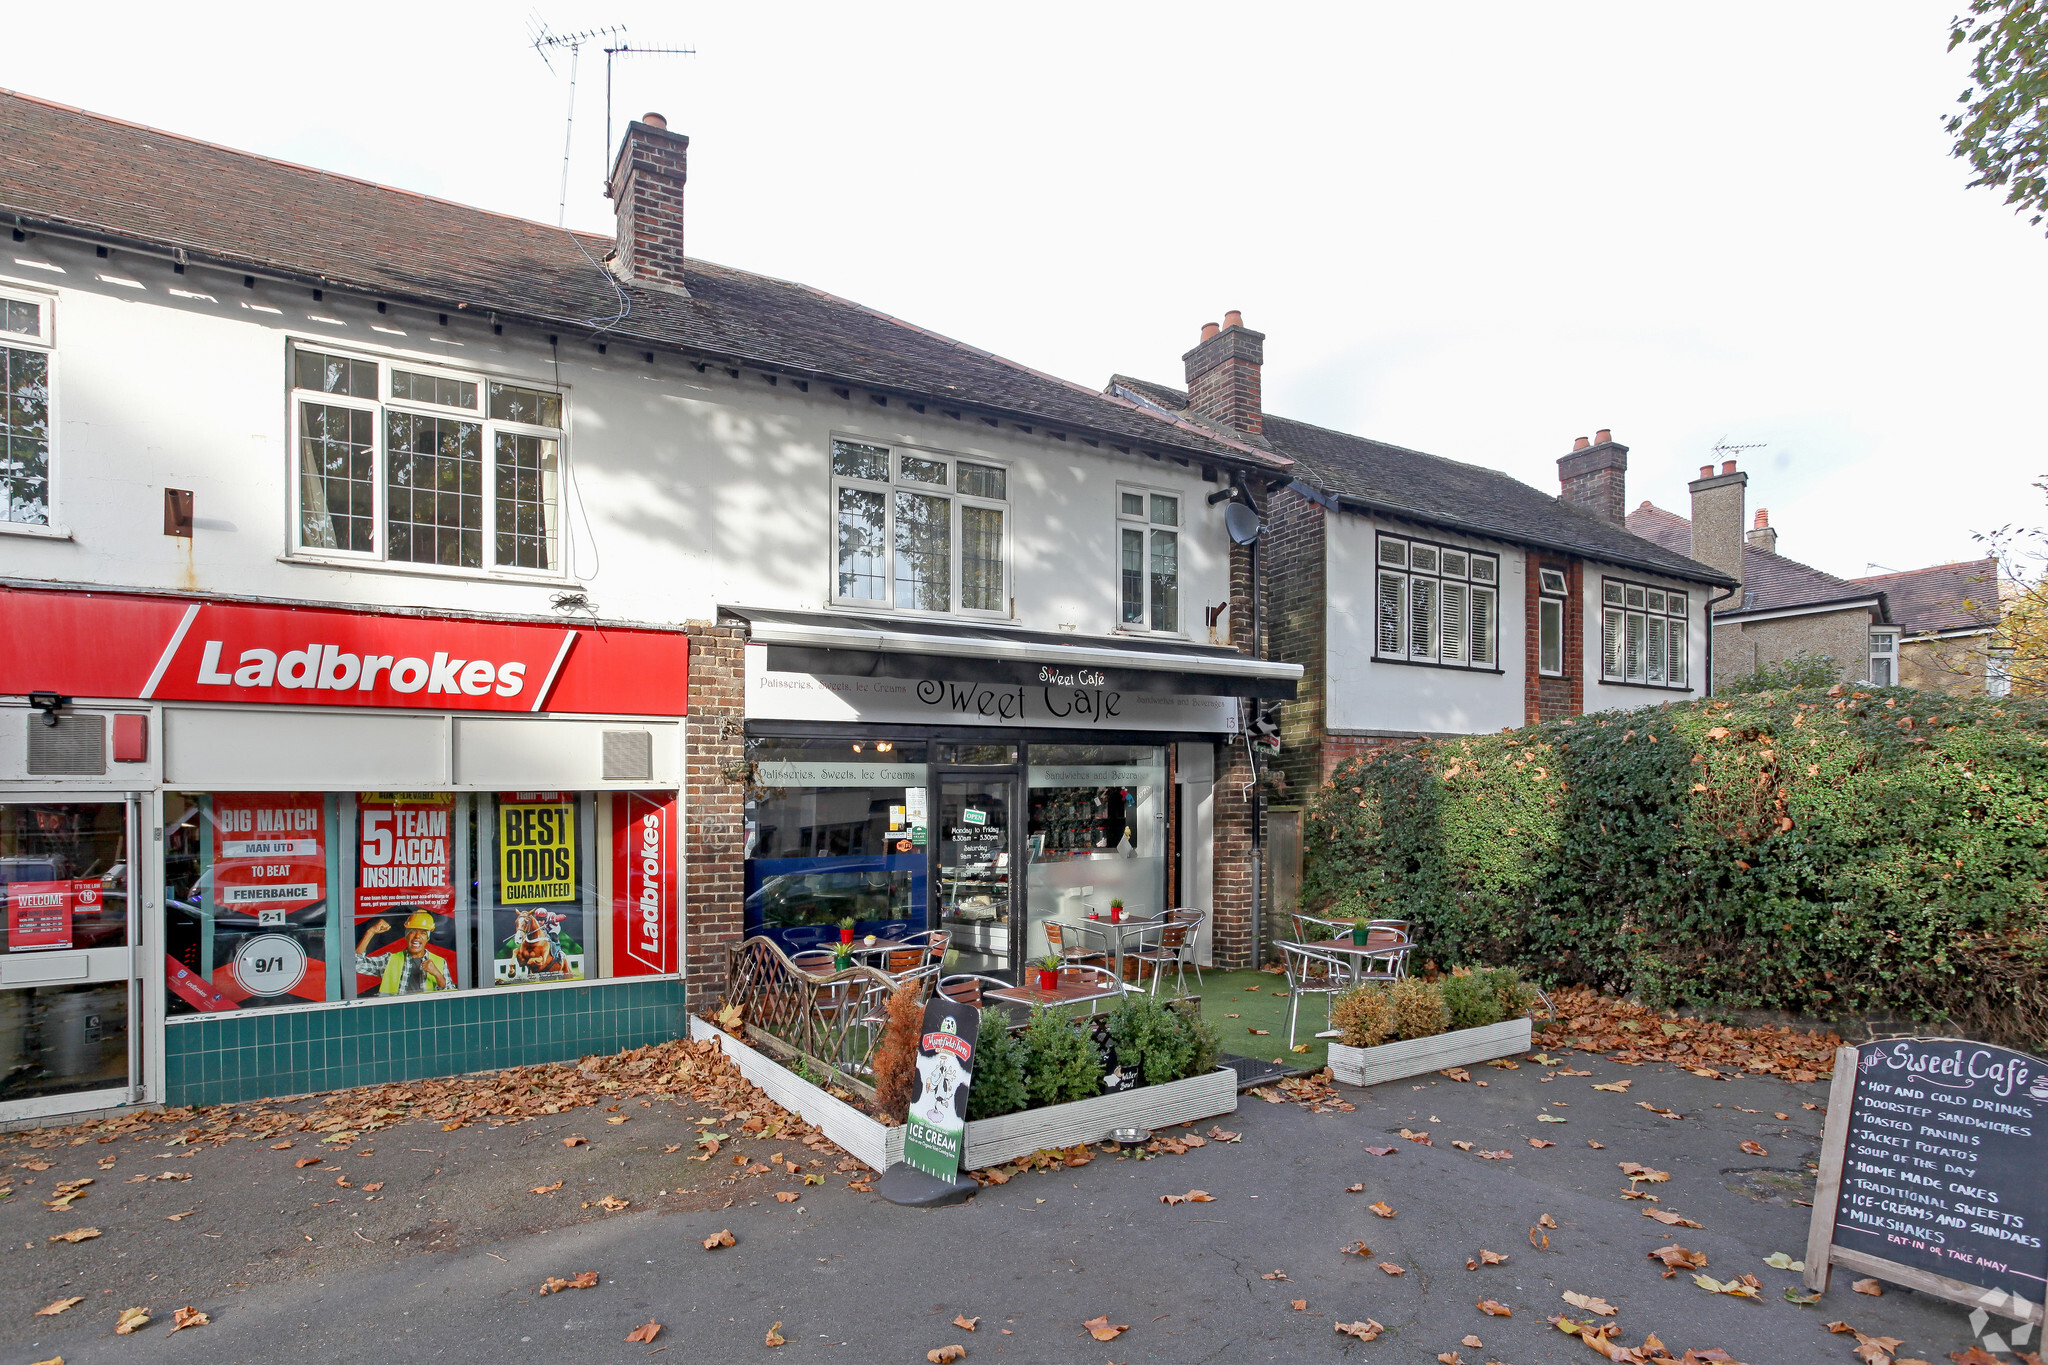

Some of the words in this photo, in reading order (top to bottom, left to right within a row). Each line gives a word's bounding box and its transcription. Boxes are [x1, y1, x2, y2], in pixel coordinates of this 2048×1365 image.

[197, 640, 526, 697] Ladbrokes
[1038, 666, 1075, 686] Sweet
[1078, 669, 1105, 687] Café
[759, 677, 814, 690] Patisseries,
[819, 680, 851, 692] Sweets,
[856, 682, 868, 692] Ice
[873, 682, 907, 693] Creams
[917, 680, 1025, 723] Sweet
[1178, 697, 1189, 706] and
[1192, 701, 1225, 709] Beverages
[1226, 717, 1236, 729] 13
[821, 768, 856, 780] Sweets,
[861, 769, 875, 780] Ice
[880, 769, 915, 780] Creams
[1045, 771, 1089, 780] Sandwiches
[1093, 771, 1107, 780] and
[222, 810, 252, 832] BIG
[257, 808, 318, 831] MATCH
[506, 808, 569, 846] BEST
[966, 813, 983, 821] OPEN
[983, 826, 999, 834] Friday
[246, 843, 270, 853] MAN
[274, 843, 294, 852] UTD
[363, 810, 392, 865] 5
[394, 810, 447, 837] TEAM
[394, 838, 446, 864] ACCA
[251, 865, 264, 877] TO
[267, 865, 291, 876] BEAT
[363, 866, 446, 888] INSURANCE
[506, 848, 570, 882] ODDS
[234, 888, 308, 900] FENERBAHCE
[507, 882, 571, 900] GUARANTEED
[640, 814, 659, 953] Ladbrokes
[18, 893, 64, 906] WELCOME
[262, 912, 281, 922] 2-1
[255, 957, 284, 972] 9/1
[1886, 1043, 1964, 1077] Sweet
[1968, 1050, 2029, 1097] Café
[1868, 1081, 1893, 1093] HOT
[1894, 1087, 1924, 1099] AND
[1930, 1092, 1967, 1106] COLD
[1972, 1099, 2033, 1119] DRINKS
[1861, 1112, 1913, 1132] TOASTED
[1920, 1126, 1981, 1146] PANINIS
[1864, 1098, 1932, 1118] DOORSTEP
[1937, 1112, 2032, 1137] SANDWICHES
[910, 1122, 924, 1138] ICE
[925, 1129, 956, 1152] CREAM
[1860, 1129, 1911, 1149] JACKET
[1915, 1141, 1978, 1162] POTATO'S
[1857, 1145, 1889, 1159] SOUP
[1893, 1153, 1910, 1164] OF
[1912, 1156, 1938, 1171] THE
[1944, 1163, 1976, 1179] DAY
[1856, 1161, 1896, 1178] HOME
[1900, 1171, 1943, 1190] MADE
[1949, 1183, 2000, 1204] CAKES
[1853, 1178, 1949, 1210] TRADITIONAL
[1954, 1203, 2025, 1229] SWEETS
[1850, 1209, 1946, 1244] MILKSHAKES
[1852, 1193, 1935, 1221] ICE-CREAMS
[1935, 1214, 1967, 1229] AND
[1970, 1222, 2042, 1248] SUNDAES
[1887, 1233, 1926, 1250] EAT-IN
[1946, 1249, 1973, 1264] TAKE
[1975, 1257, 2008, 1273] AWAY
